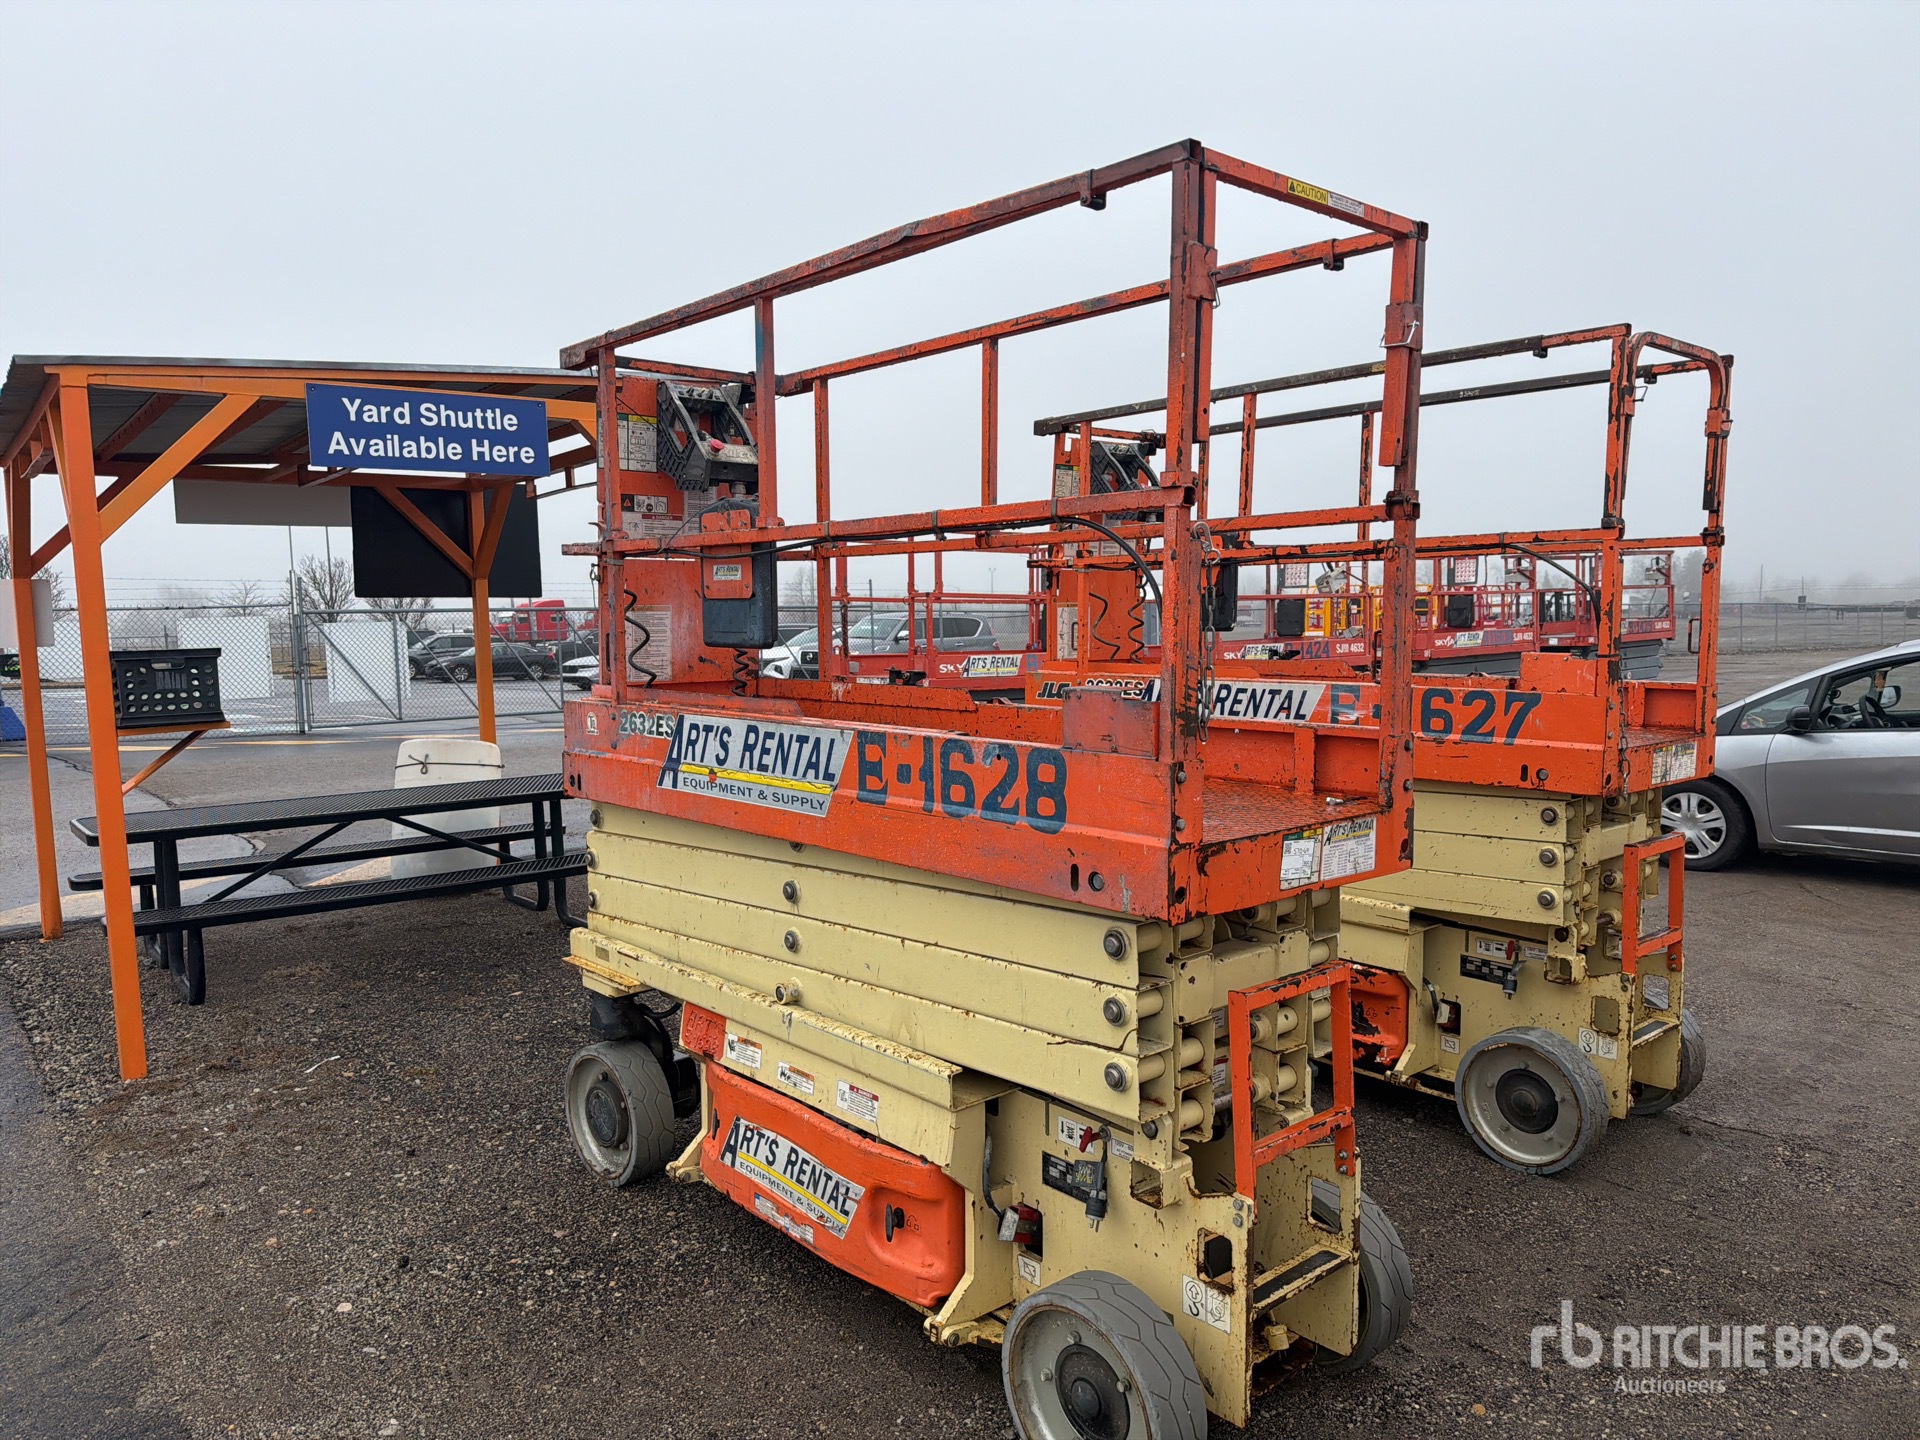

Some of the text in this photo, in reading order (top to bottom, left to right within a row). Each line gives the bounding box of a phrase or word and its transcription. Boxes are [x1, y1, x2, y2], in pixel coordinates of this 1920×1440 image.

[1295, 183, 1327, 203] CAUTION
[341, 397, 519, 431] Yard Shuttle
[328, 431, 535, 464] Available Here
[962, 656, 1018, 677] ART'S RENTAL
[1213, 684, 1308, 722] RENTAL
[658, 714, 837, 789] ART'S RENTAL
[683, 777, 826, 811] EQUIPMENT & SUPPLY
[720, 1116, 851, 1217] ART'S RENTAL
[739, 1161, 794, 1199] EQUIPMENT
